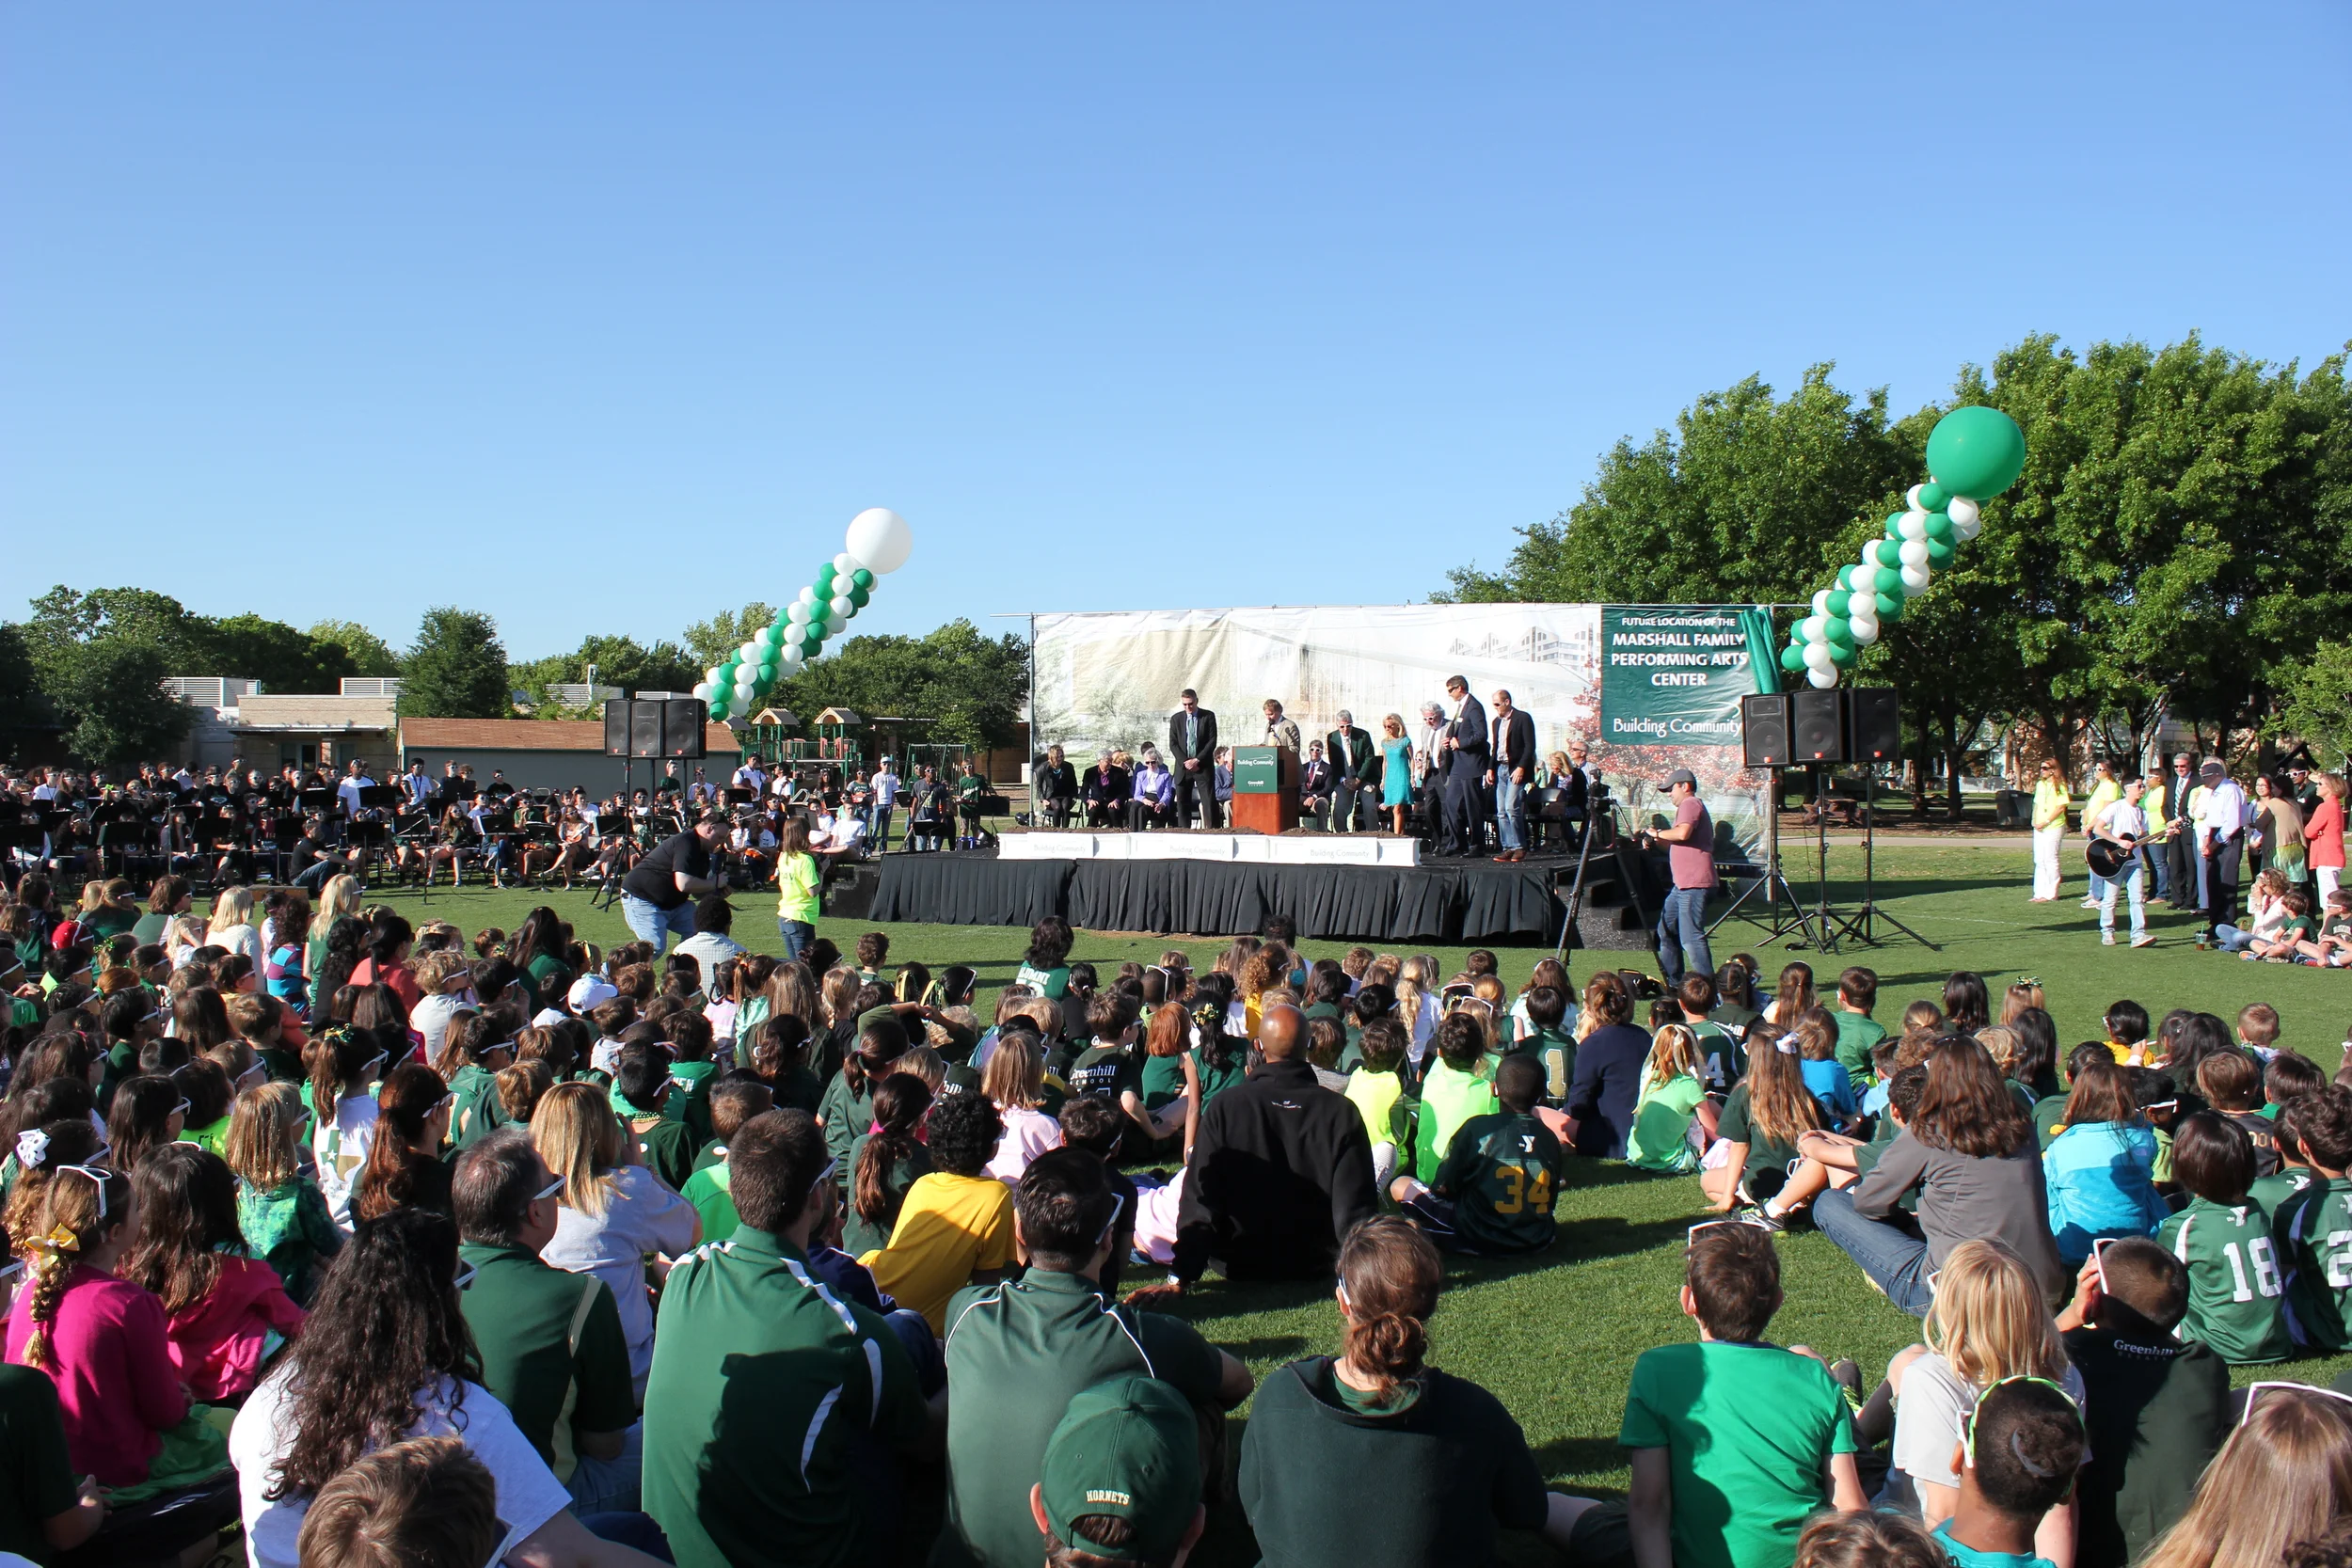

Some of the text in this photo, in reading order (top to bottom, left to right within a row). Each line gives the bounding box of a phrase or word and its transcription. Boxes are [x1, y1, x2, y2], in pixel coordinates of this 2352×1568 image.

[1621, 617, 1736, 626] FUTURE LOCATION OF THE
[1612, 633, 1745, 646] MARSHALL FAMILY
[1611, 652, 1749, 666] PERFORMING ARTS
[1651, 673, 1708, 686] CENTER
[1613, 718, 1742, 737] Building Community
[1071, 1064, 1116, 1081] reenhill
[1545, 1048, 1566, 1100] 1
[1494, 1165, 1551, 1214] 34
[2223, 1236, 2283, 1303] 18
[2113, 1338, 2174, 1356] Greenhill
[1086, 1489, 1130, 1506] HORNETS
